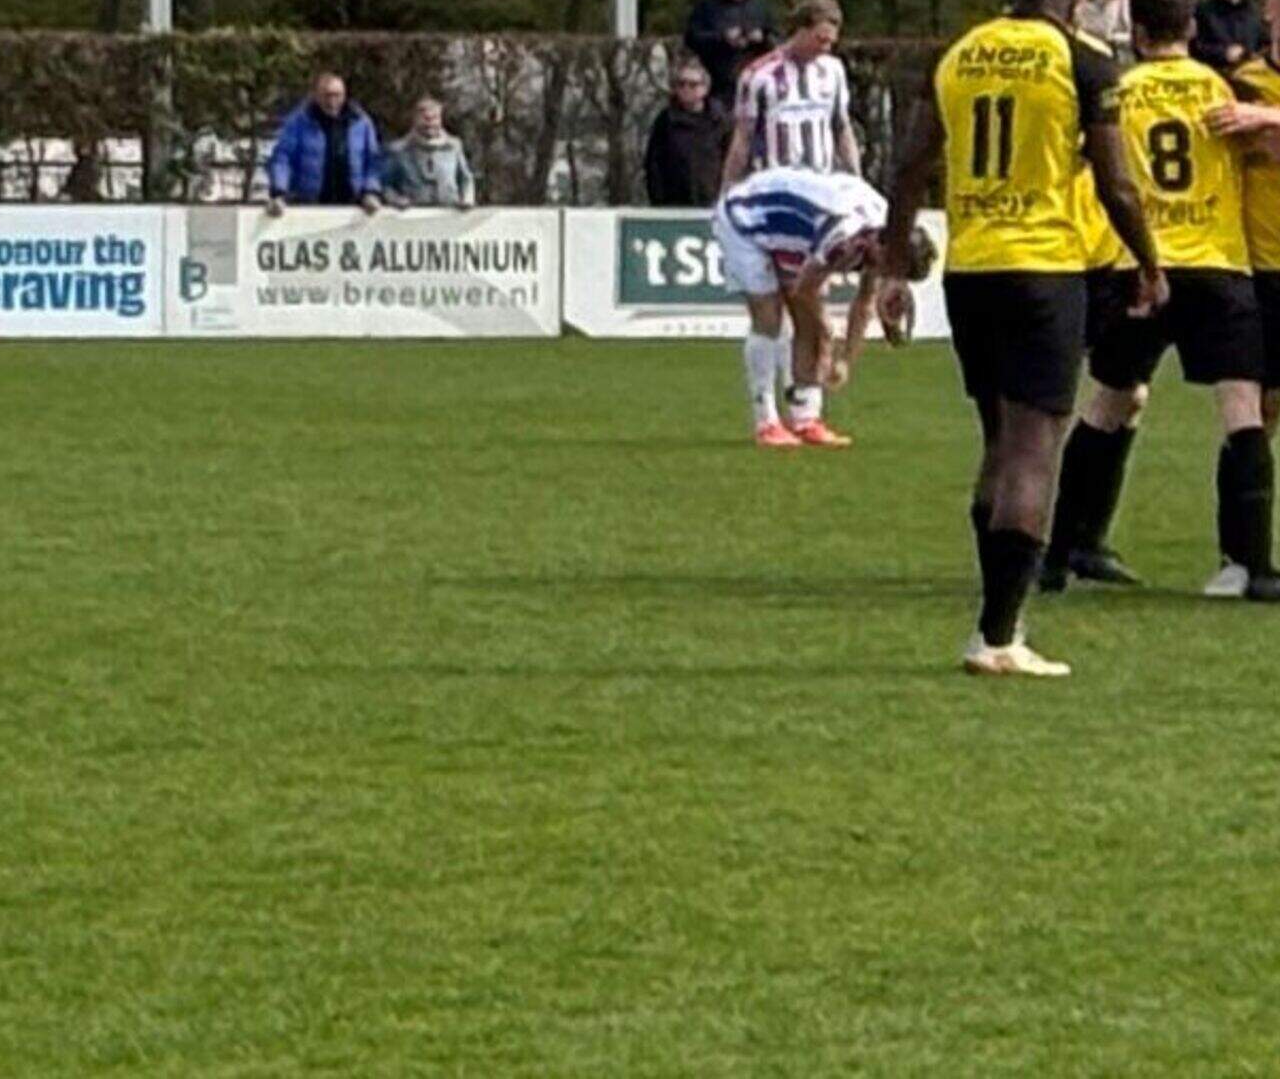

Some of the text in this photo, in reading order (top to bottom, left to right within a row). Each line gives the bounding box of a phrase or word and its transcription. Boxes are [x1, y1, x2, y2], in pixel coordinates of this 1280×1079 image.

[972, 94, 1017, 181] 11
[1147, 120, 1194, 193] 8
[92, 234, 145, 267] the
[256, 239, 539, 274] GLAS & ALUMINIUM
[256, 281, 540, 310] www.breeuwer.nl
